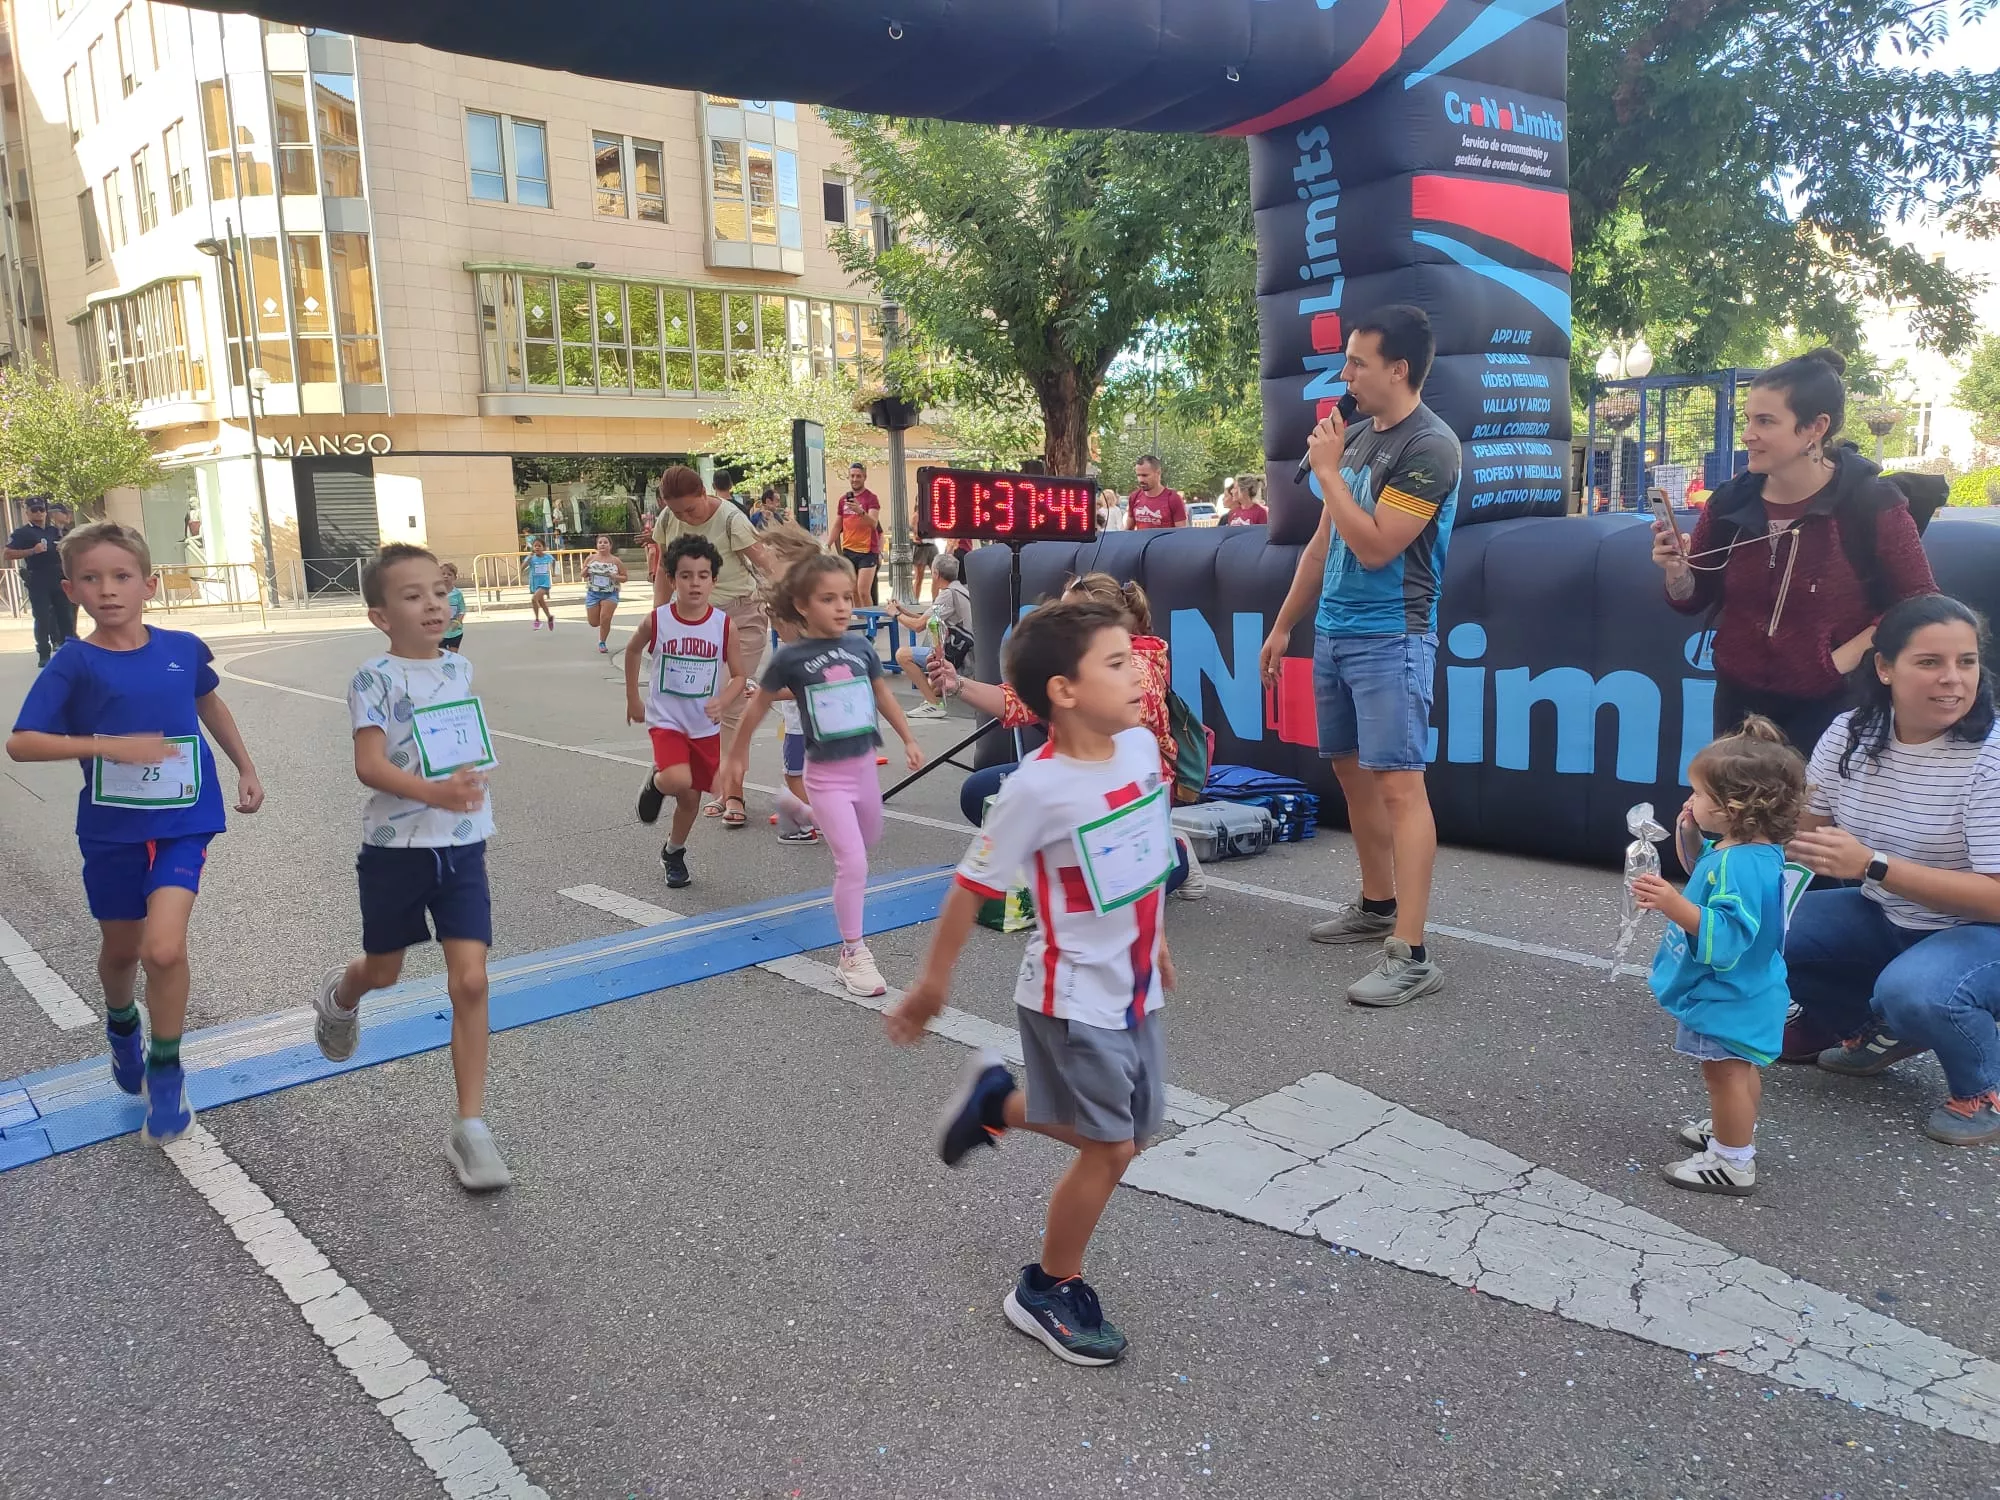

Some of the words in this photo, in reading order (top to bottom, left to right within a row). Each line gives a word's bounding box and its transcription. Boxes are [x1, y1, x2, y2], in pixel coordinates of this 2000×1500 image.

[1461, 133, 1489, 149] Servicio
[1490, 138, 1500, 151] de
[1500, 142, 1543, 161] cronometraje
[1542, 151, 1549, 162] y
[1455, 153, 1481, 167] gestión
[1482, 156, 1492, 168] de
[1492, 159, 1520, 172] eventos
[1519, 163, 1552, 178] deportivos
[1490, 328, 1512, 343] APP
[1512, 329, 1533, 344] LIVE
[1512, 373, 1549, 388] RESUMEN
[1483, 398, 1518, 413] VALLAS
[1519, 397, 1526, 412] Y
[1526, 397, 1551, 412] ARCOS
[1472, 423, 1501, 439] BOLSA
[1502, 422, 1550, 436] CORREDOR
[270, 433, 392, 457] MANGO
[1472, 443, 1517, 458] SPEAKER
[1515, 442, 1523, 455] Y
[1473, 465, 1514, 484] TROFEOS
[1515, 465, 1523, 479] Y
[1524, 464, 1562, 480] MEDALLAS
[1471, 492, 1495, 509] CHIP
[1494, 489, 1529, 504] ACTIVO
[1529, 489, 1535, 501] Y
[1534, 488, 1561, 502] PASIVO
[662, 638, 677, 655] AIR
[678, 637, 718, 658] JORDAN
[684, 674, 696, 684] 20
[142, 767, 161, 781] 25
